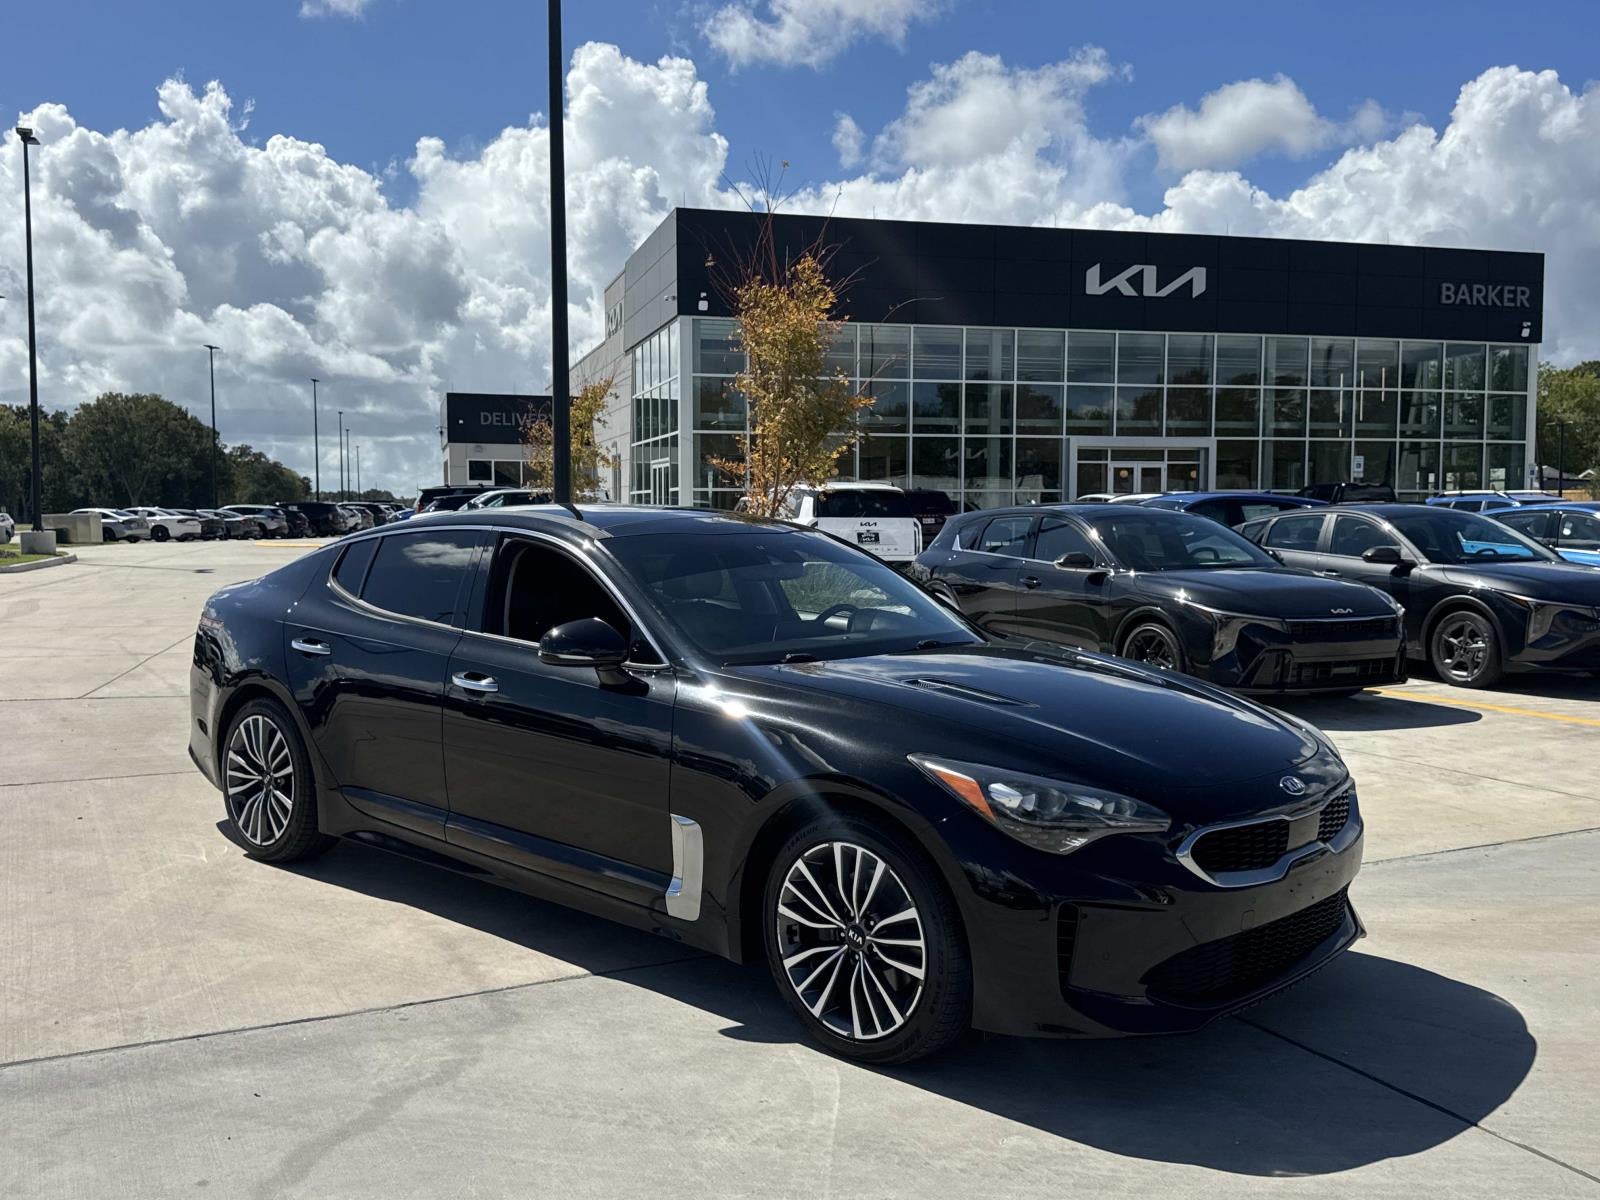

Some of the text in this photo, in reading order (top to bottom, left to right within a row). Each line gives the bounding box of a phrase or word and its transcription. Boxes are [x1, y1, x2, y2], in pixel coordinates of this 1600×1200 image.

[1086, 263, 1206, 298] KIA
[1440, 283, 1530, 308] BARKER
[480, 411, 552, 426] DELIVER
[848, 929, 863, 945] KIA
